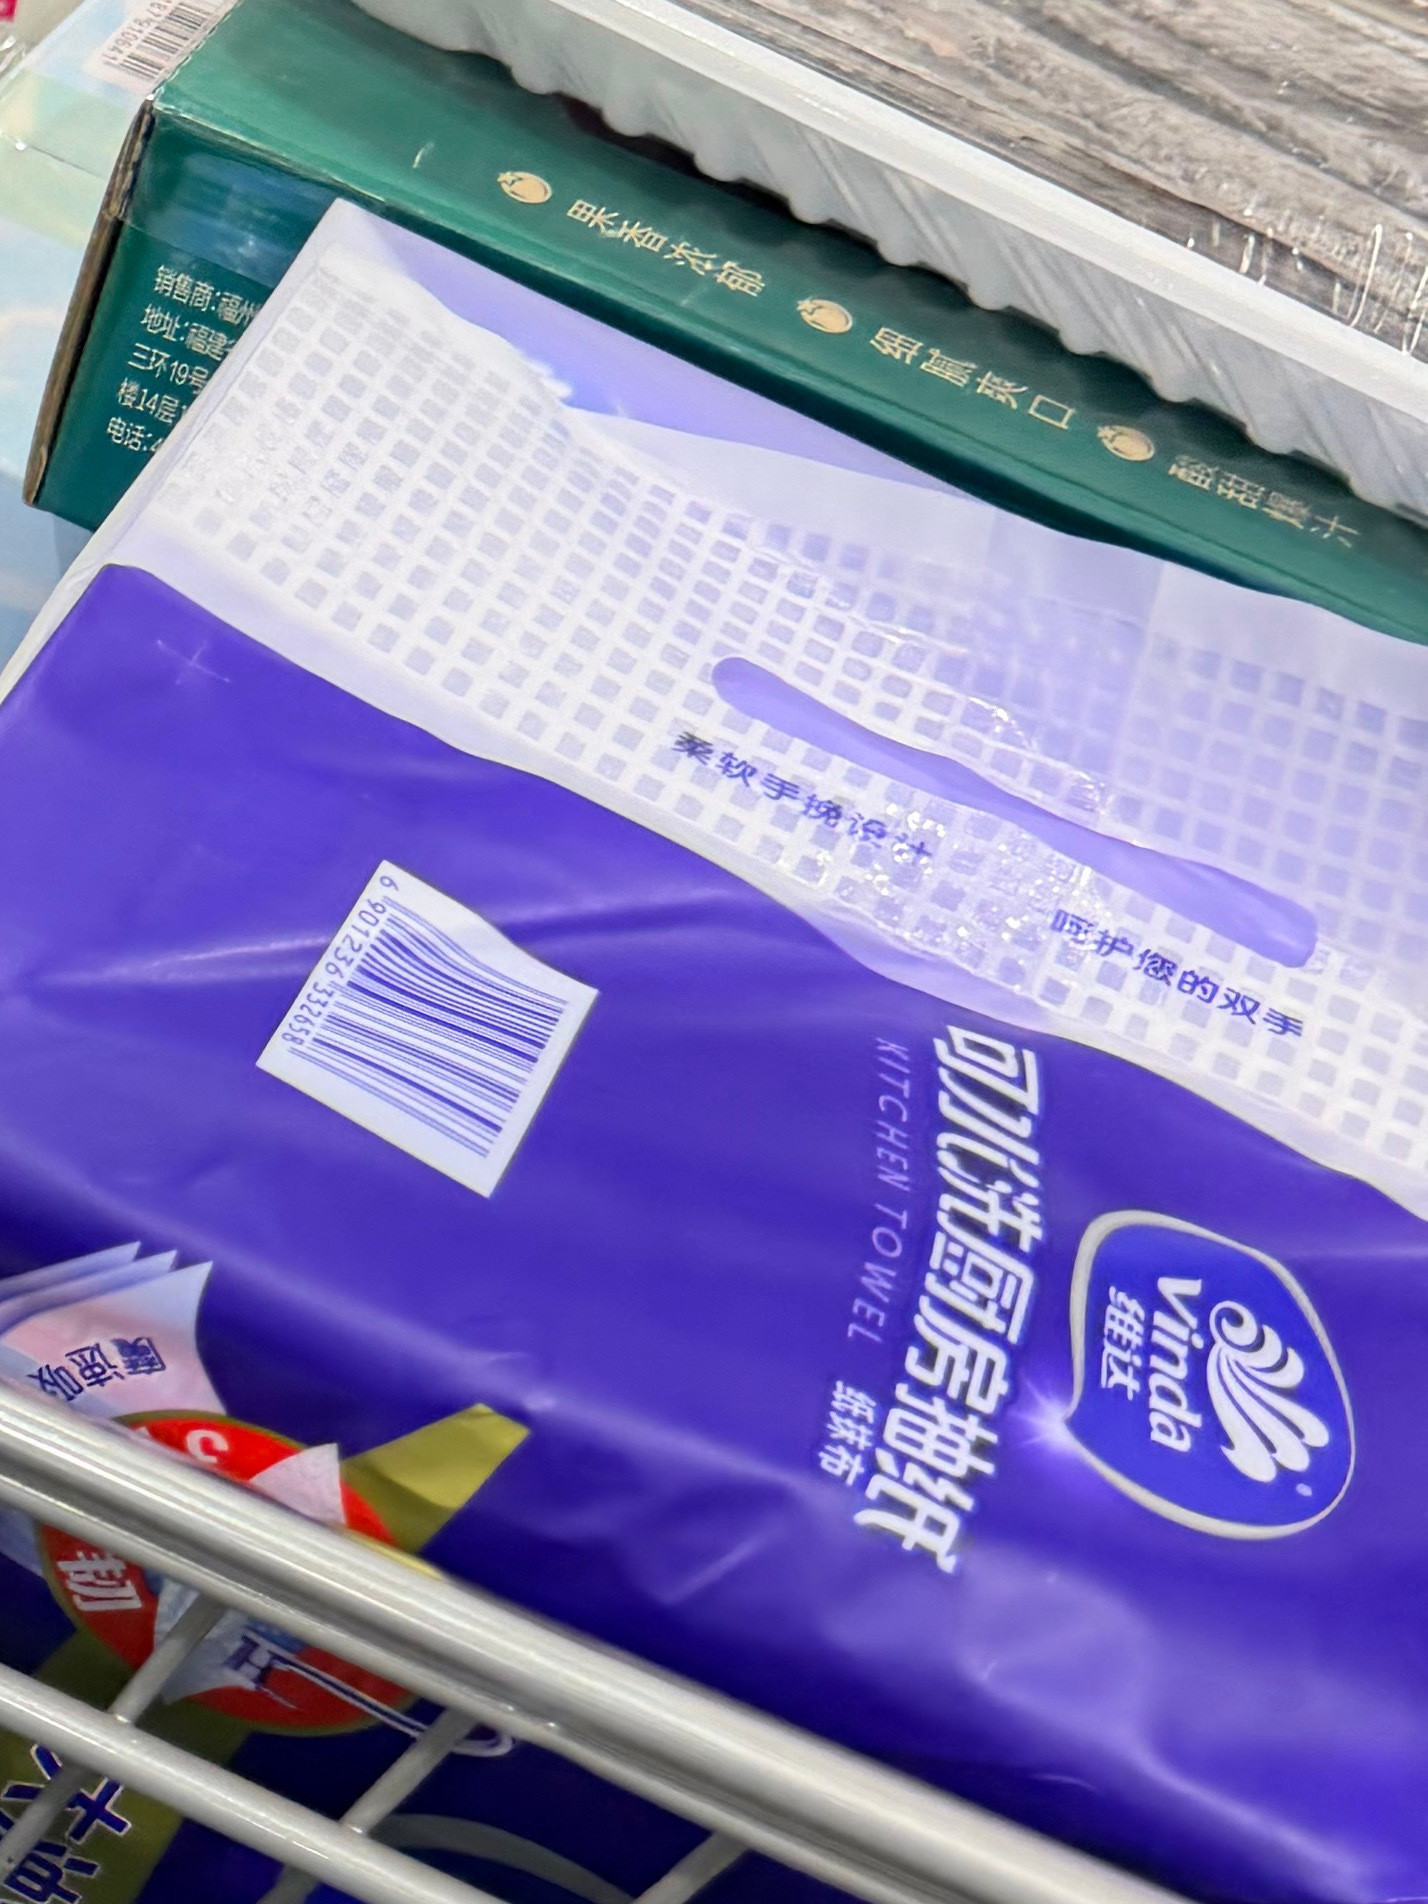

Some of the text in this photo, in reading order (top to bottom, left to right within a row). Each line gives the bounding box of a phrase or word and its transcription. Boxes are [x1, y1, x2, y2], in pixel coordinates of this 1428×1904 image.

[564, 196, 768, 300] 果香浓郁
[868, 323, 1077, 433] 细腻爽口
[324, 898, 387, 982] 901236
[671, 728, 1306, 1039] 柔软手挽设计 呵护您的双手
[280, 982, 335, 1047] 332658
[846, 1036, 913, 1346] KITCHEN TOWEL
[853, 1024, 1044, 1575] 可水洗厨房抽纸
[1099, 1285, 1145, 1402] 维达
[1149, 1274, 1204, 1453] Vinda
